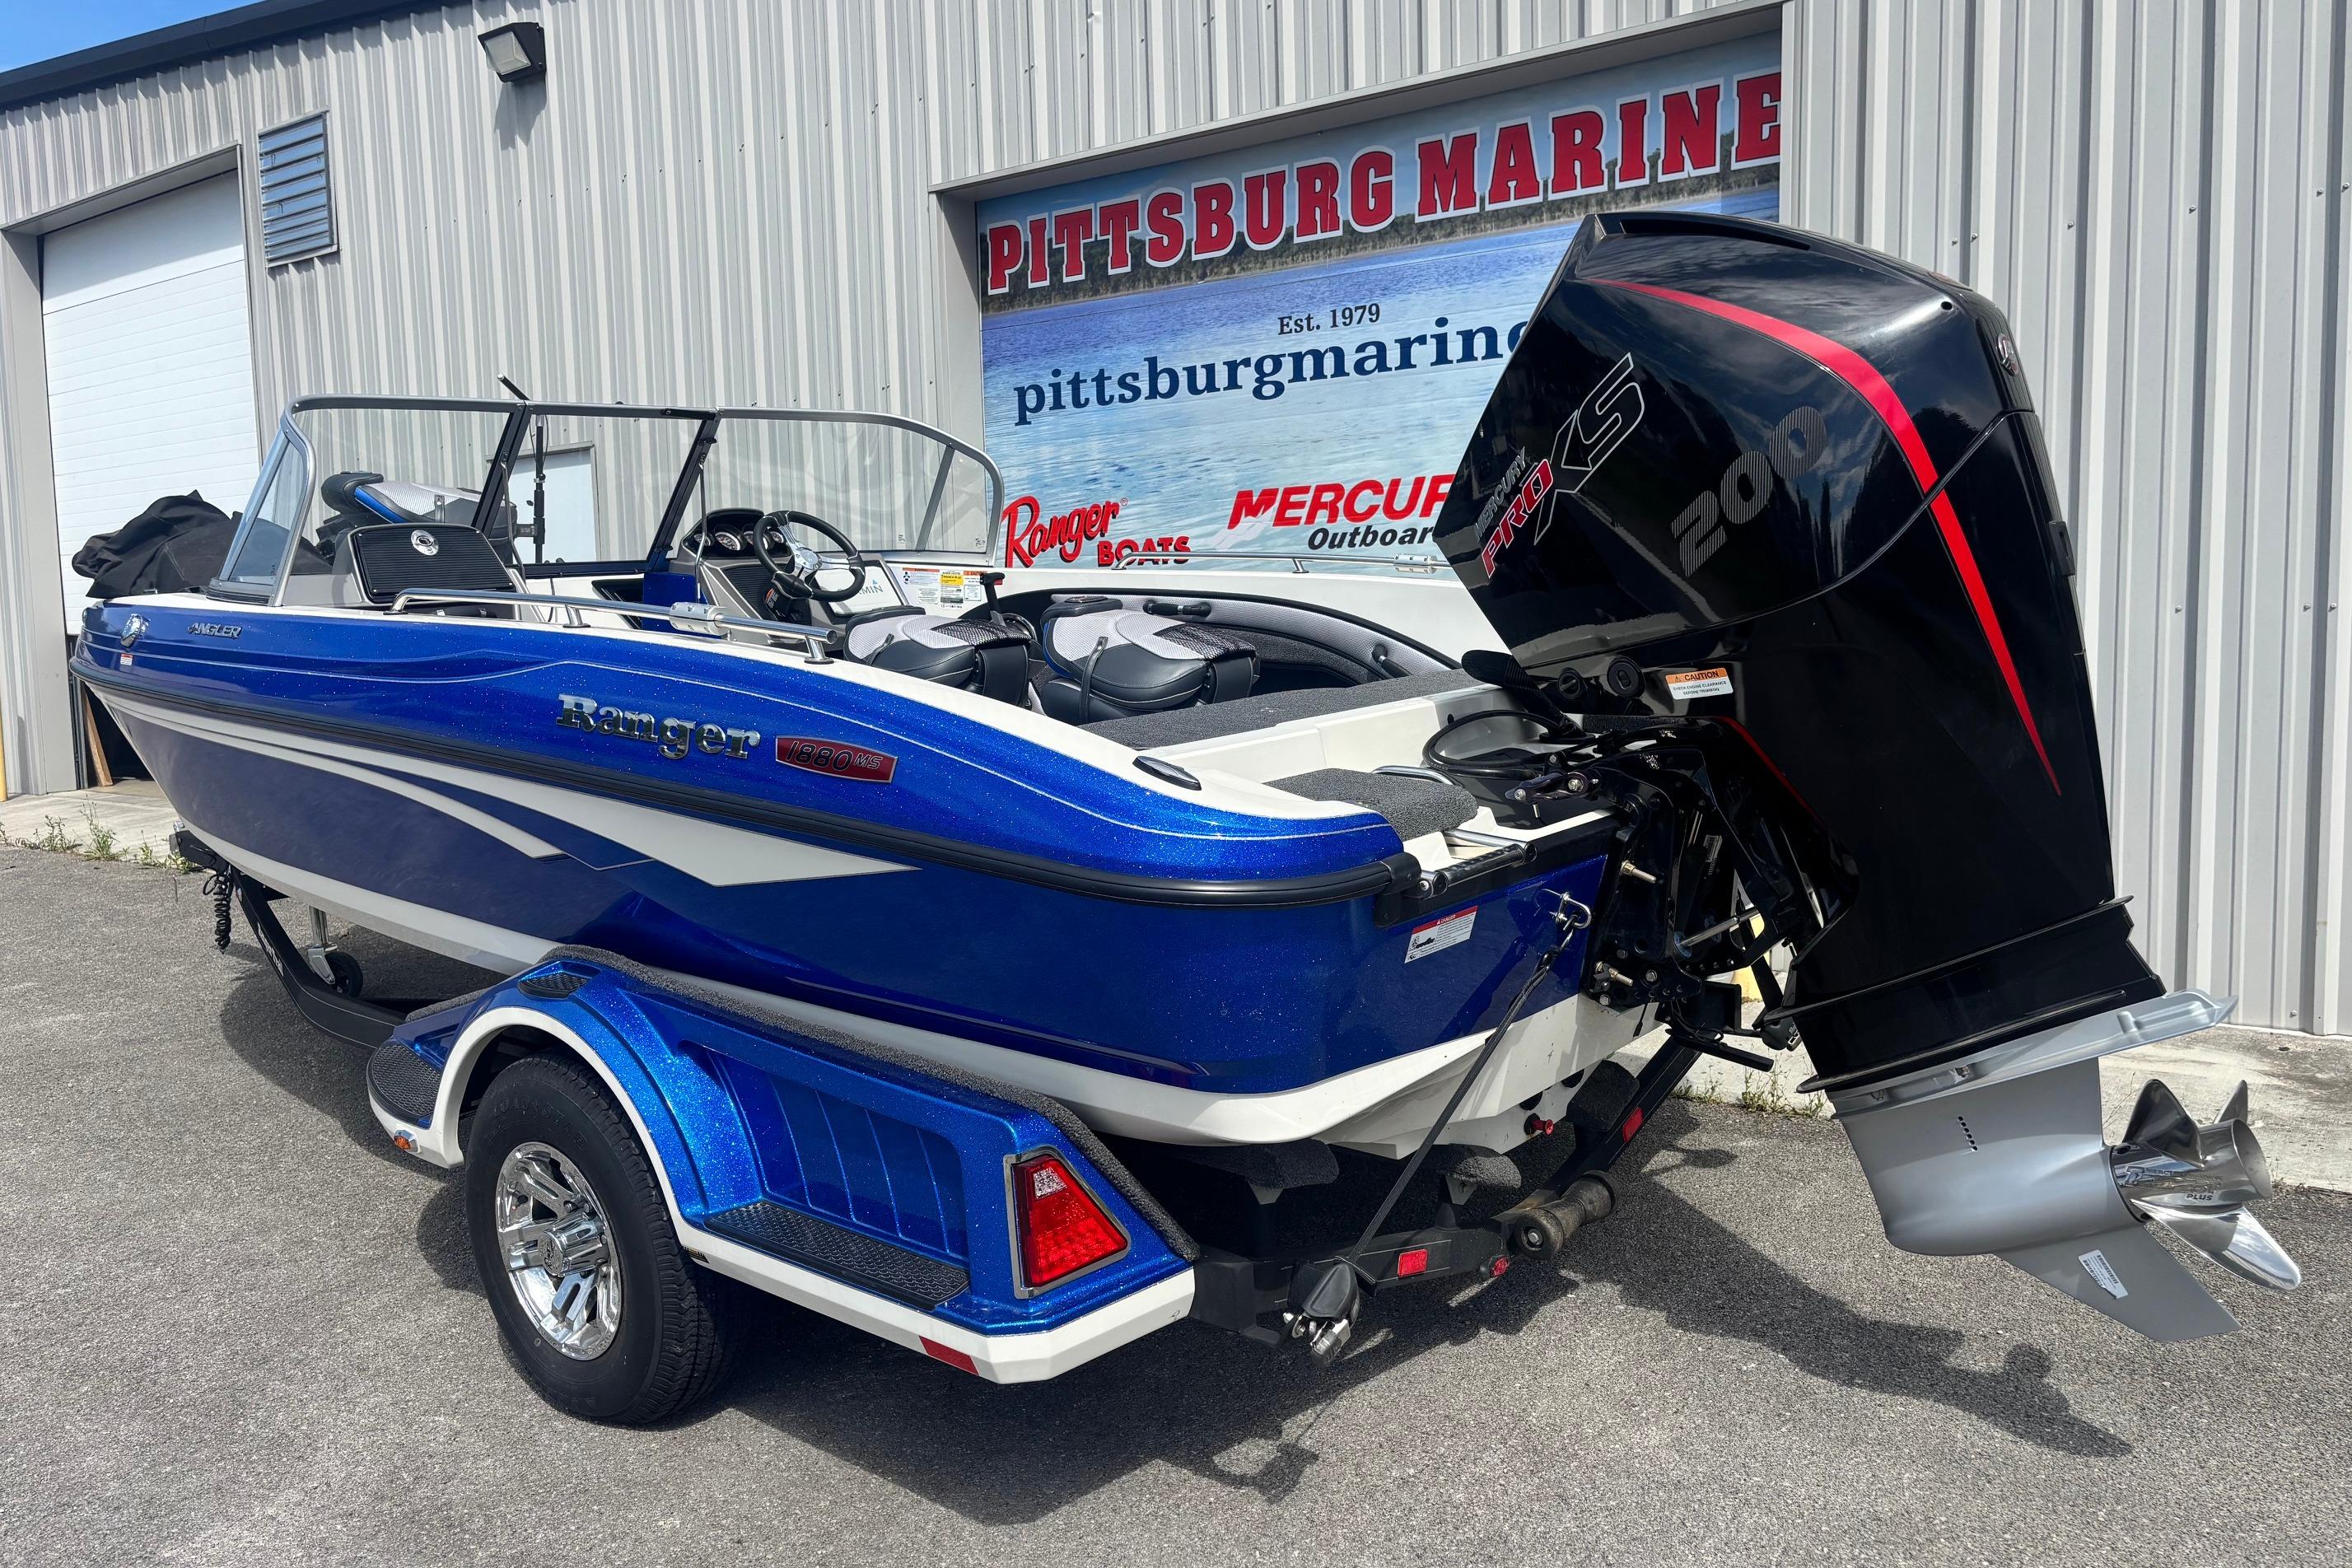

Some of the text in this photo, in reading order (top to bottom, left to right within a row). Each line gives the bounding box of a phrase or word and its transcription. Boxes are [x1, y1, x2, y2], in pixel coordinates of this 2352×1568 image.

[987, 68, 1780, 295] PITTSBURG MARINE
[1278, 303, 1380, 335] Est. 1979
[1227, 474, 1456, 530] MERCUR
[1474, 446, 1526, 542] MERCURY
[1670, 406, 1828, 577] 200
[1002, 495, 1120, 568] Ranger
[1308, 525, 1435, 550] Outboar
[1482, 458, 1554, 579] PRO
[1098, 535, 1192, 567] BOATS
[188, 622, 243, 639] ANGLER
[1684, 670, 1720, 682] CAUTION
[555, 693, 762, 760] Ranger
[786, 740, 884, 772] 1880 MS
[2186, 1193, 2214, 1202] PLUS
